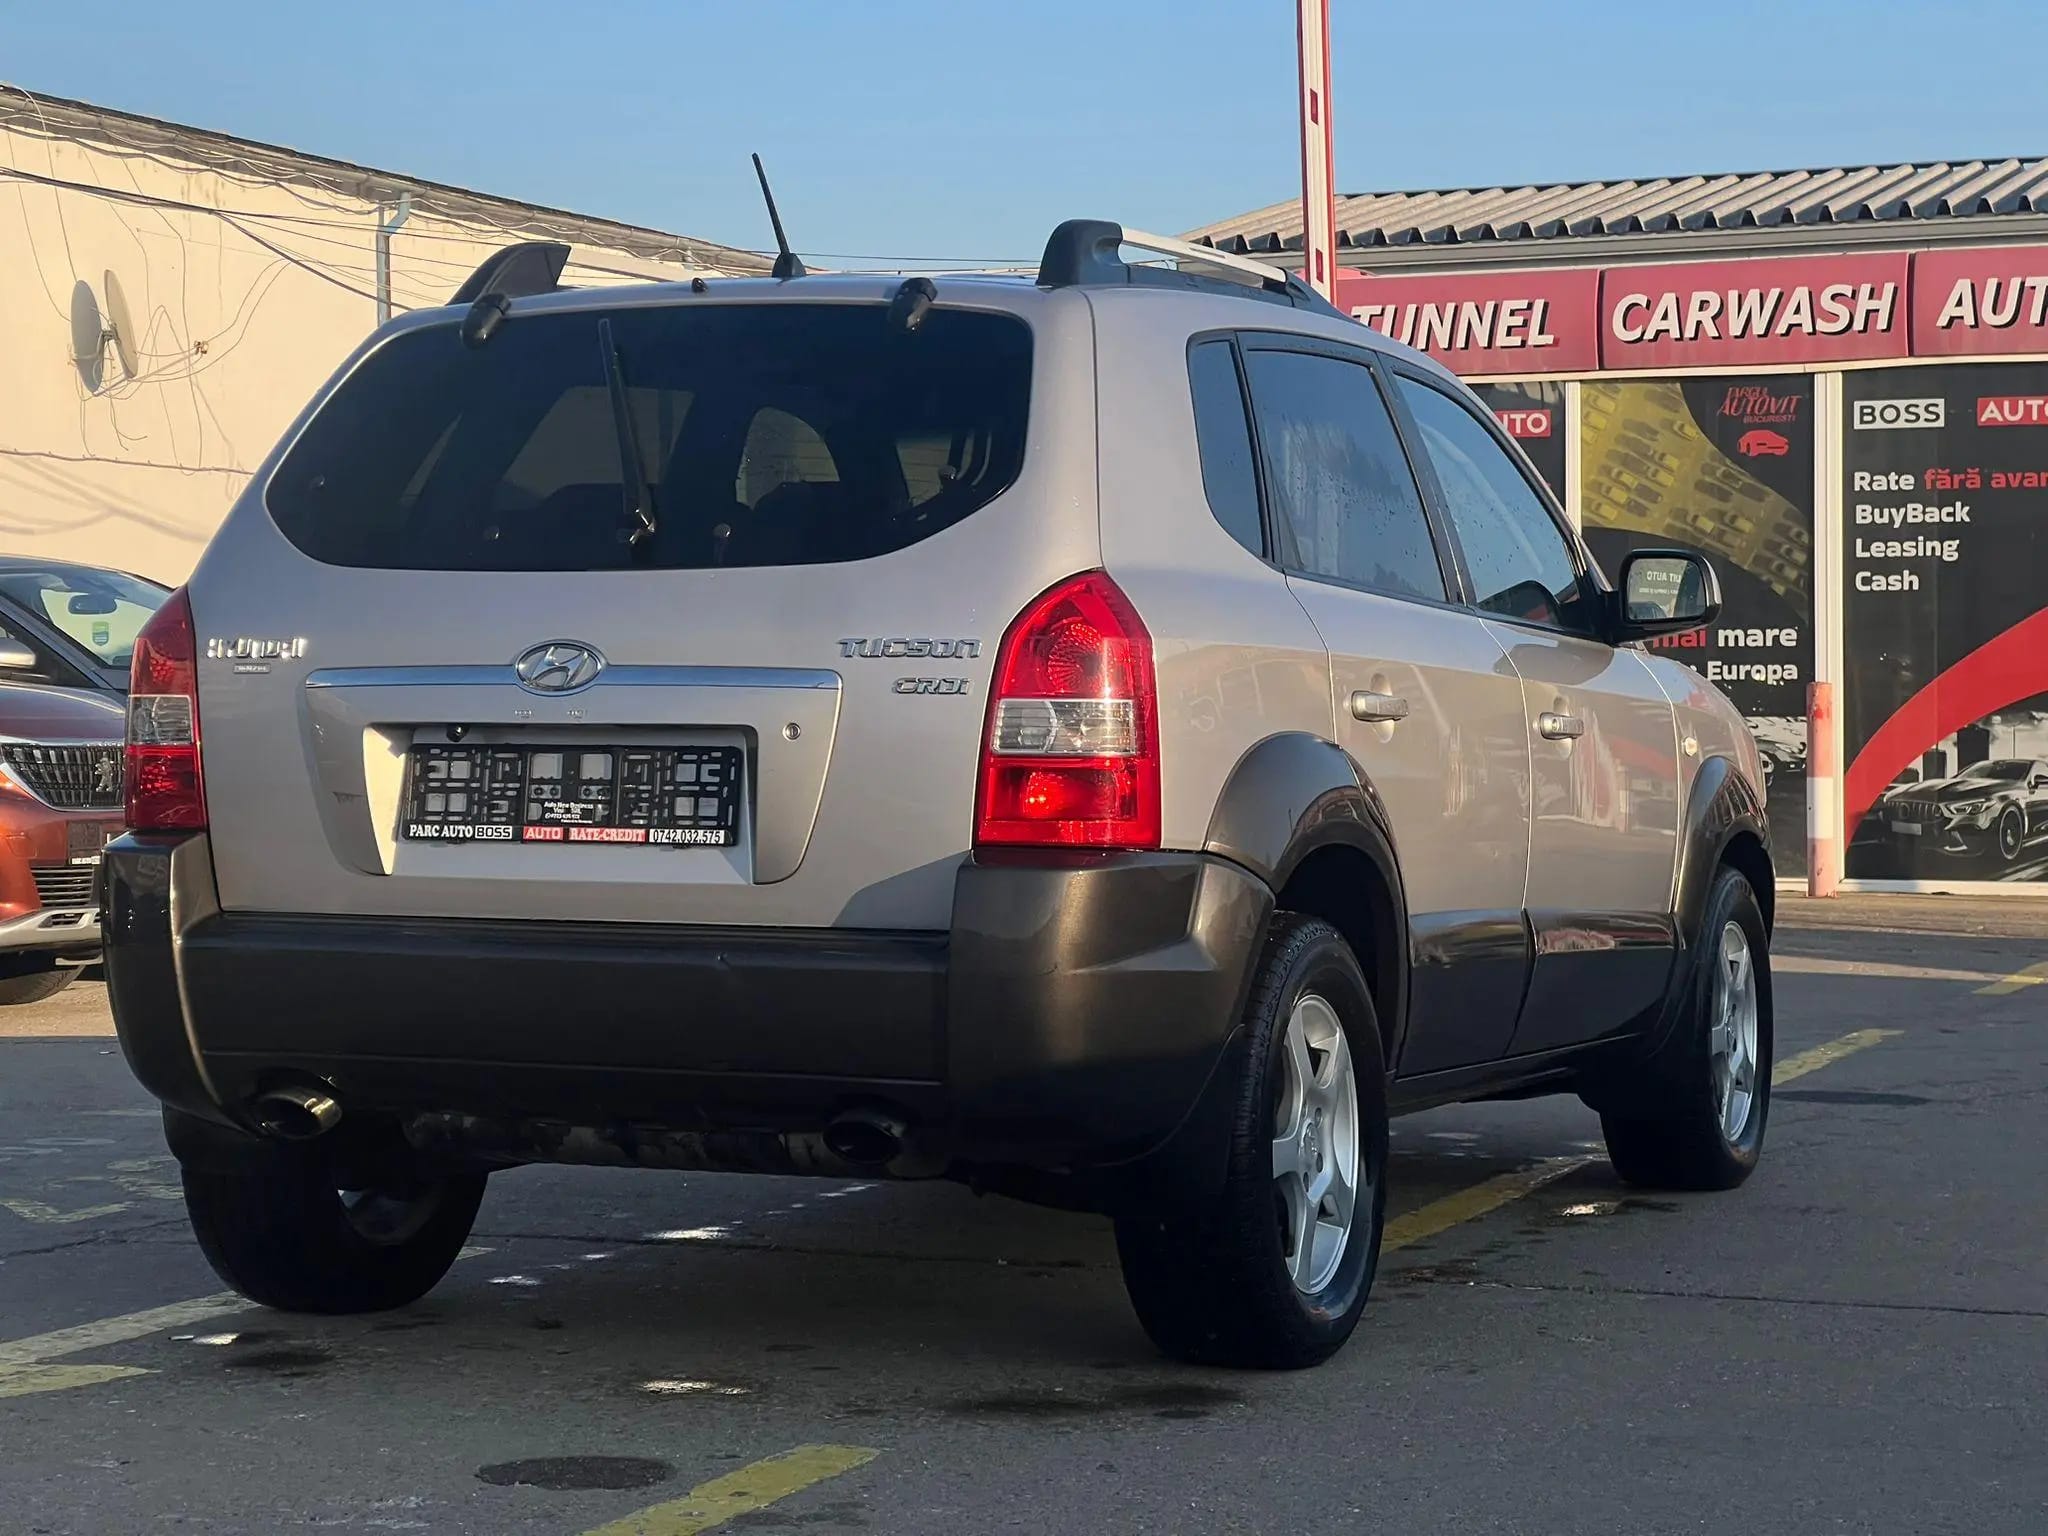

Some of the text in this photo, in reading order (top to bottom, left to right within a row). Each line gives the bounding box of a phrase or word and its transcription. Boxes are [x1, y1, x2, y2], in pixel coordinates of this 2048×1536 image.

[1351, 298, 1558, 351] TUNNEL
[1611, 281, 1898, 343] CARWASH
[1716, 395, 1803, 416] AUTOVIT
[1859, 403, 1941, 425] BOSS
[1980, 399, 2048, 422] AUT
[1853, 471, 1915, 492] Rate
[1924, 468, 1981, 490] fără
[1855, 501, 1971, 528] BuyBack
[1855, 535, 1960, 562] Leasing
[1855, 569, 1920, 592] Cash
[838, 637, 983, 659] TUCSON
[1717, 627, 1798, 648] mare
[1707, 660, 1798, 685] Europa
[409, 824, 440, 838] PARC
[441, 825, 473, 838] AUTO
[476, 826, 512, 839] BOSS
[525, 827, 562, 840] AUTO
